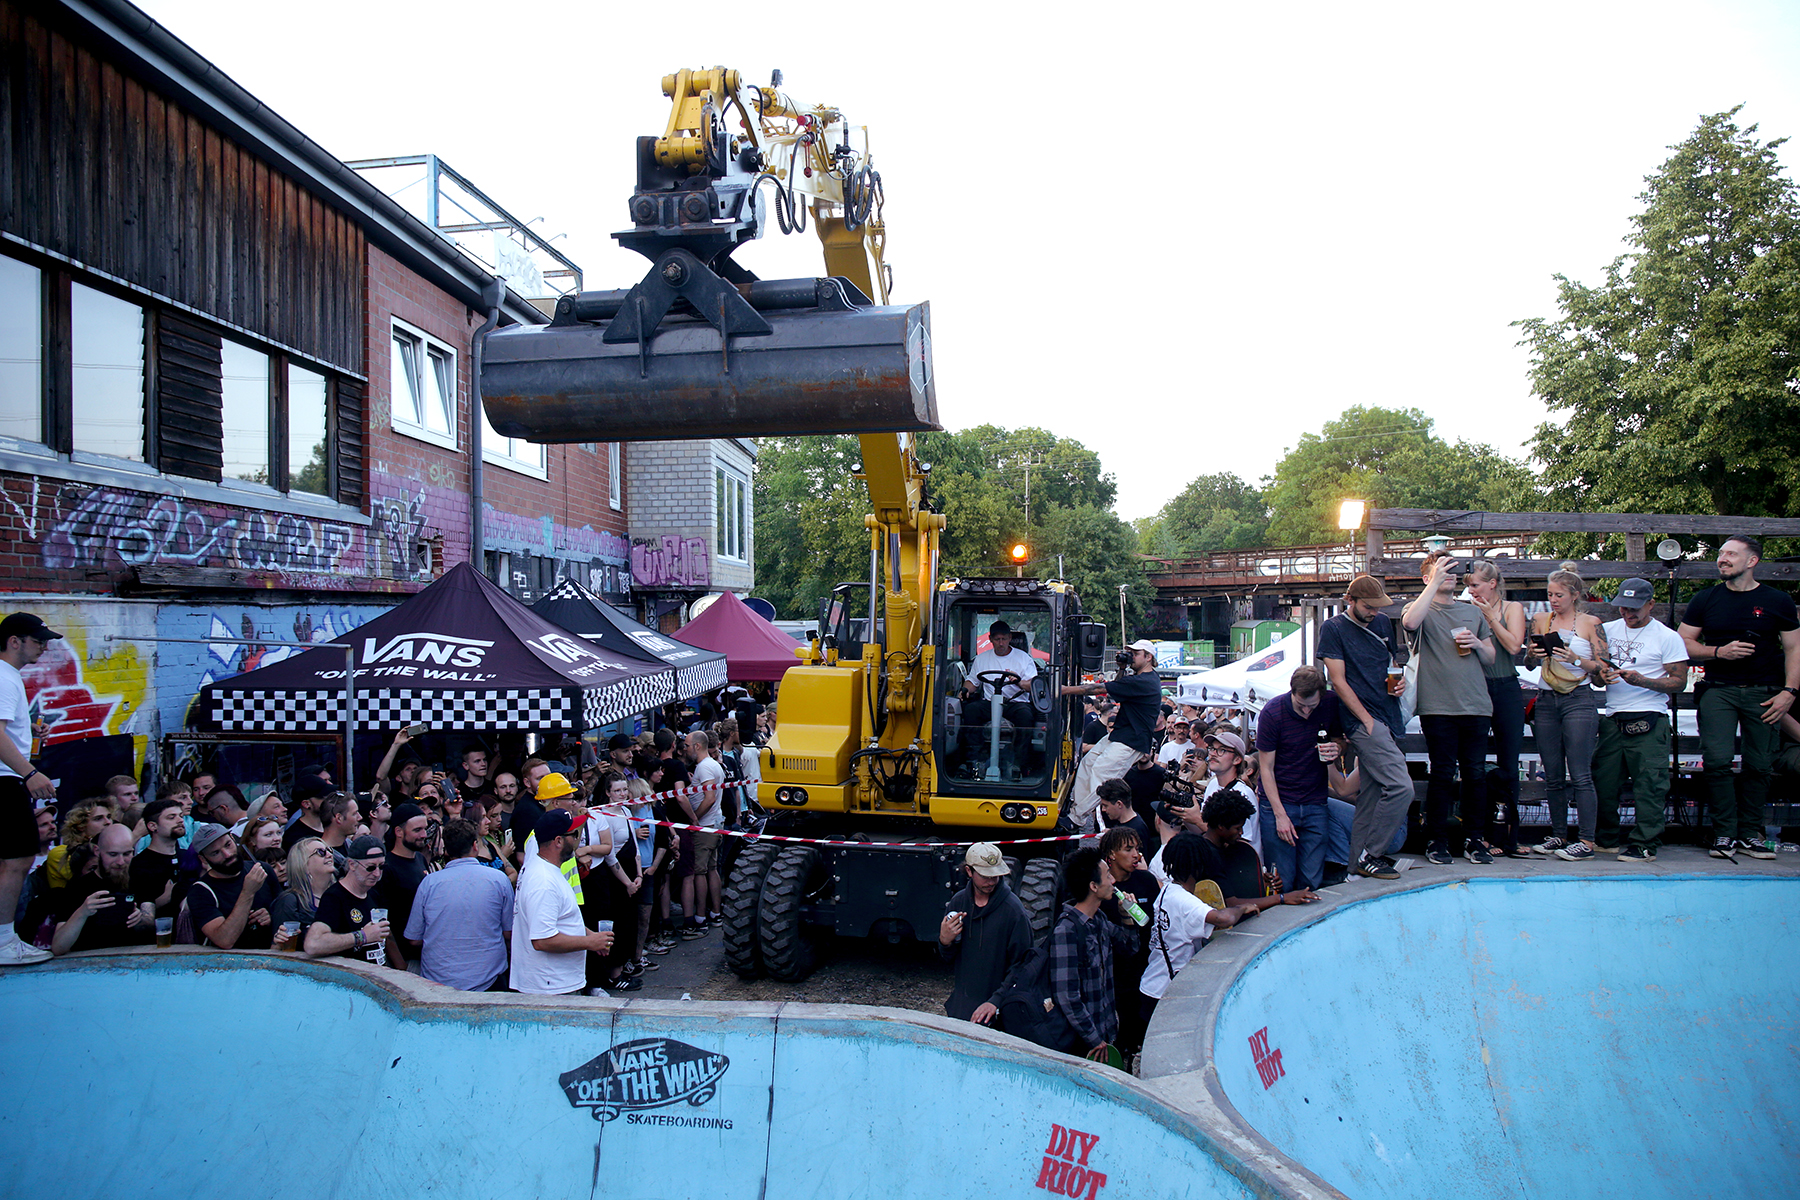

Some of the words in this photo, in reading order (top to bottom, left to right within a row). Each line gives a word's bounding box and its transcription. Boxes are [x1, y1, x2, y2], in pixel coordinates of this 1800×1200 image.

[362, 632, 496, 668] VANS
[526, 633, 601, 664] VA
[373, 666, 418, 677] THE
[423, 669, 496, 682] WALL"
[609, 1041, 669, 1073] VANS
[1248, 1026, 1272, 1063] DIY
[617, 1067, 661, 1101] THE
[661, 1054, 722, 1098] WALL"
[1255, 1048, 1286, 1090] RIOT
[626, 1113, 733, 1130] SKATEBOARDING
[1045, 1123, 1100, 1167] DIY
[1035, 1156, 1107, 1200] RIOT
